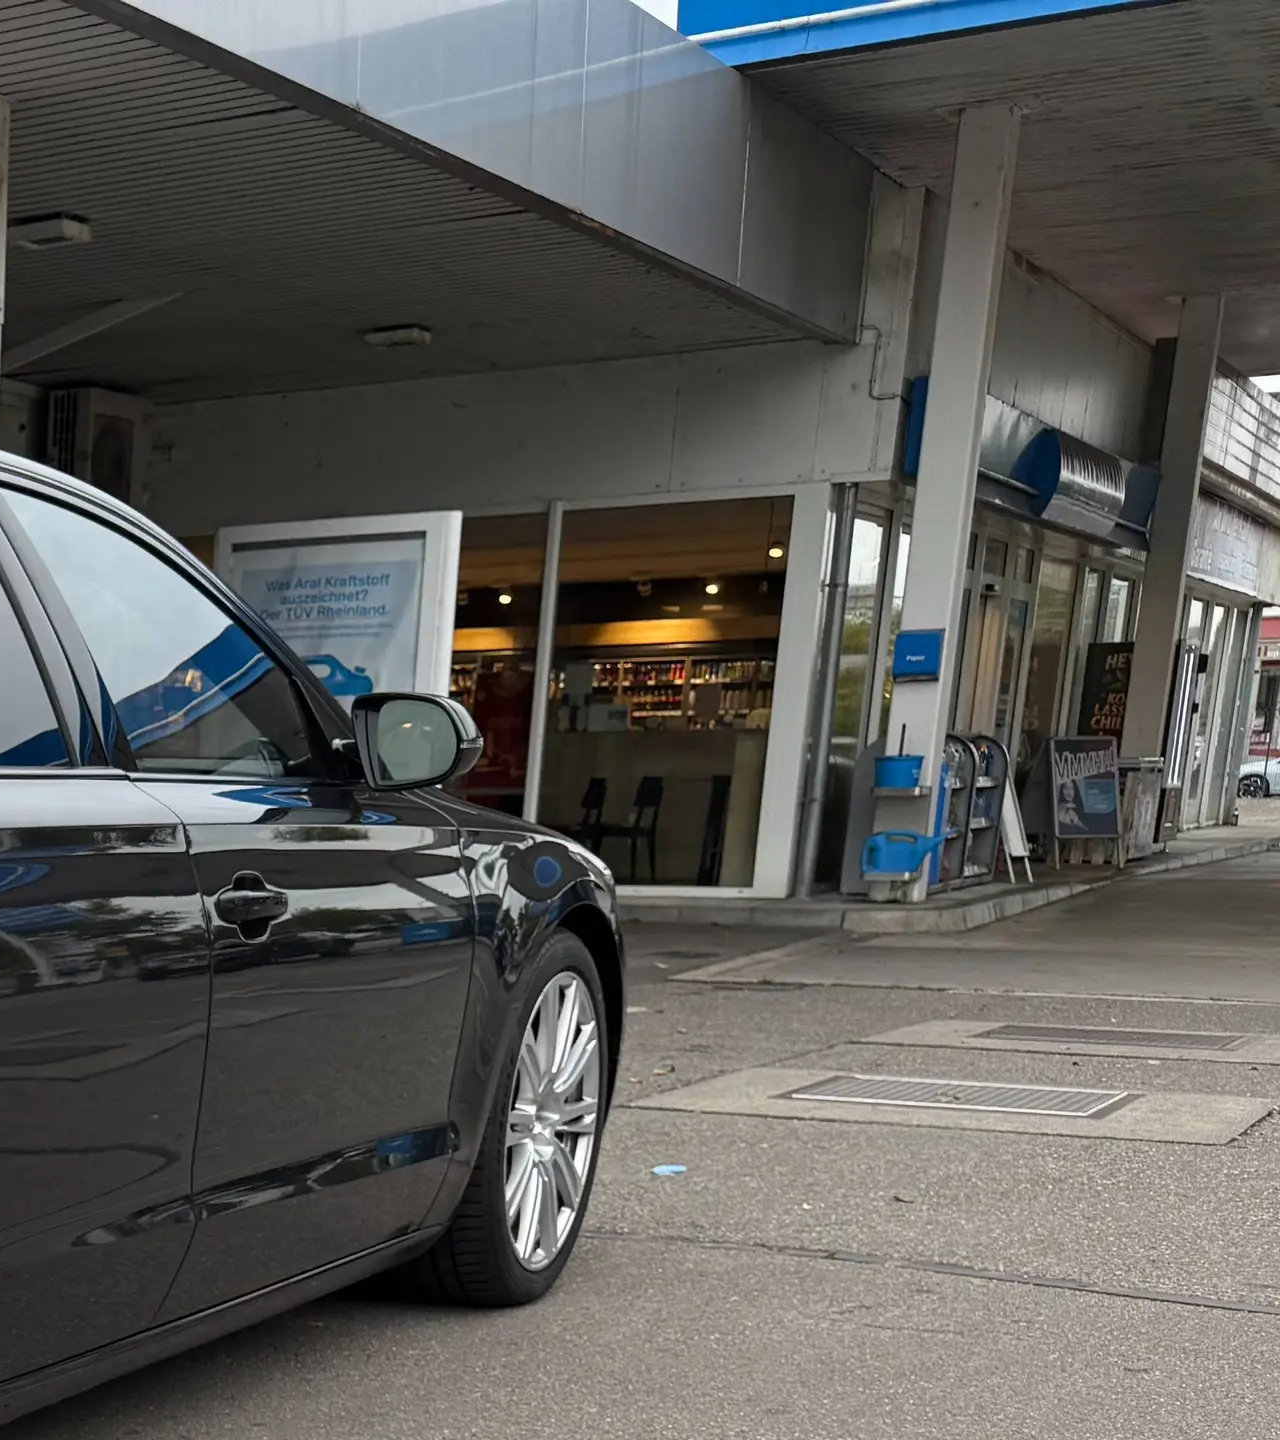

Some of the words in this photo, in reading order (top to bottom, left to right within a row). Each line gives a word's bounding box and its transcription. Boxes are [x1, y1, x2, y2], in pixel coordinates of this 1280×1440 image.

[265, 580, 291, 592] Was
[294, 577, 321, 590] Aral
[324, 572, 390, 589] Kraftstoff
[280, 589, 369, 605] auszeichnet?
[286, 605, 314, 620] TÜV
